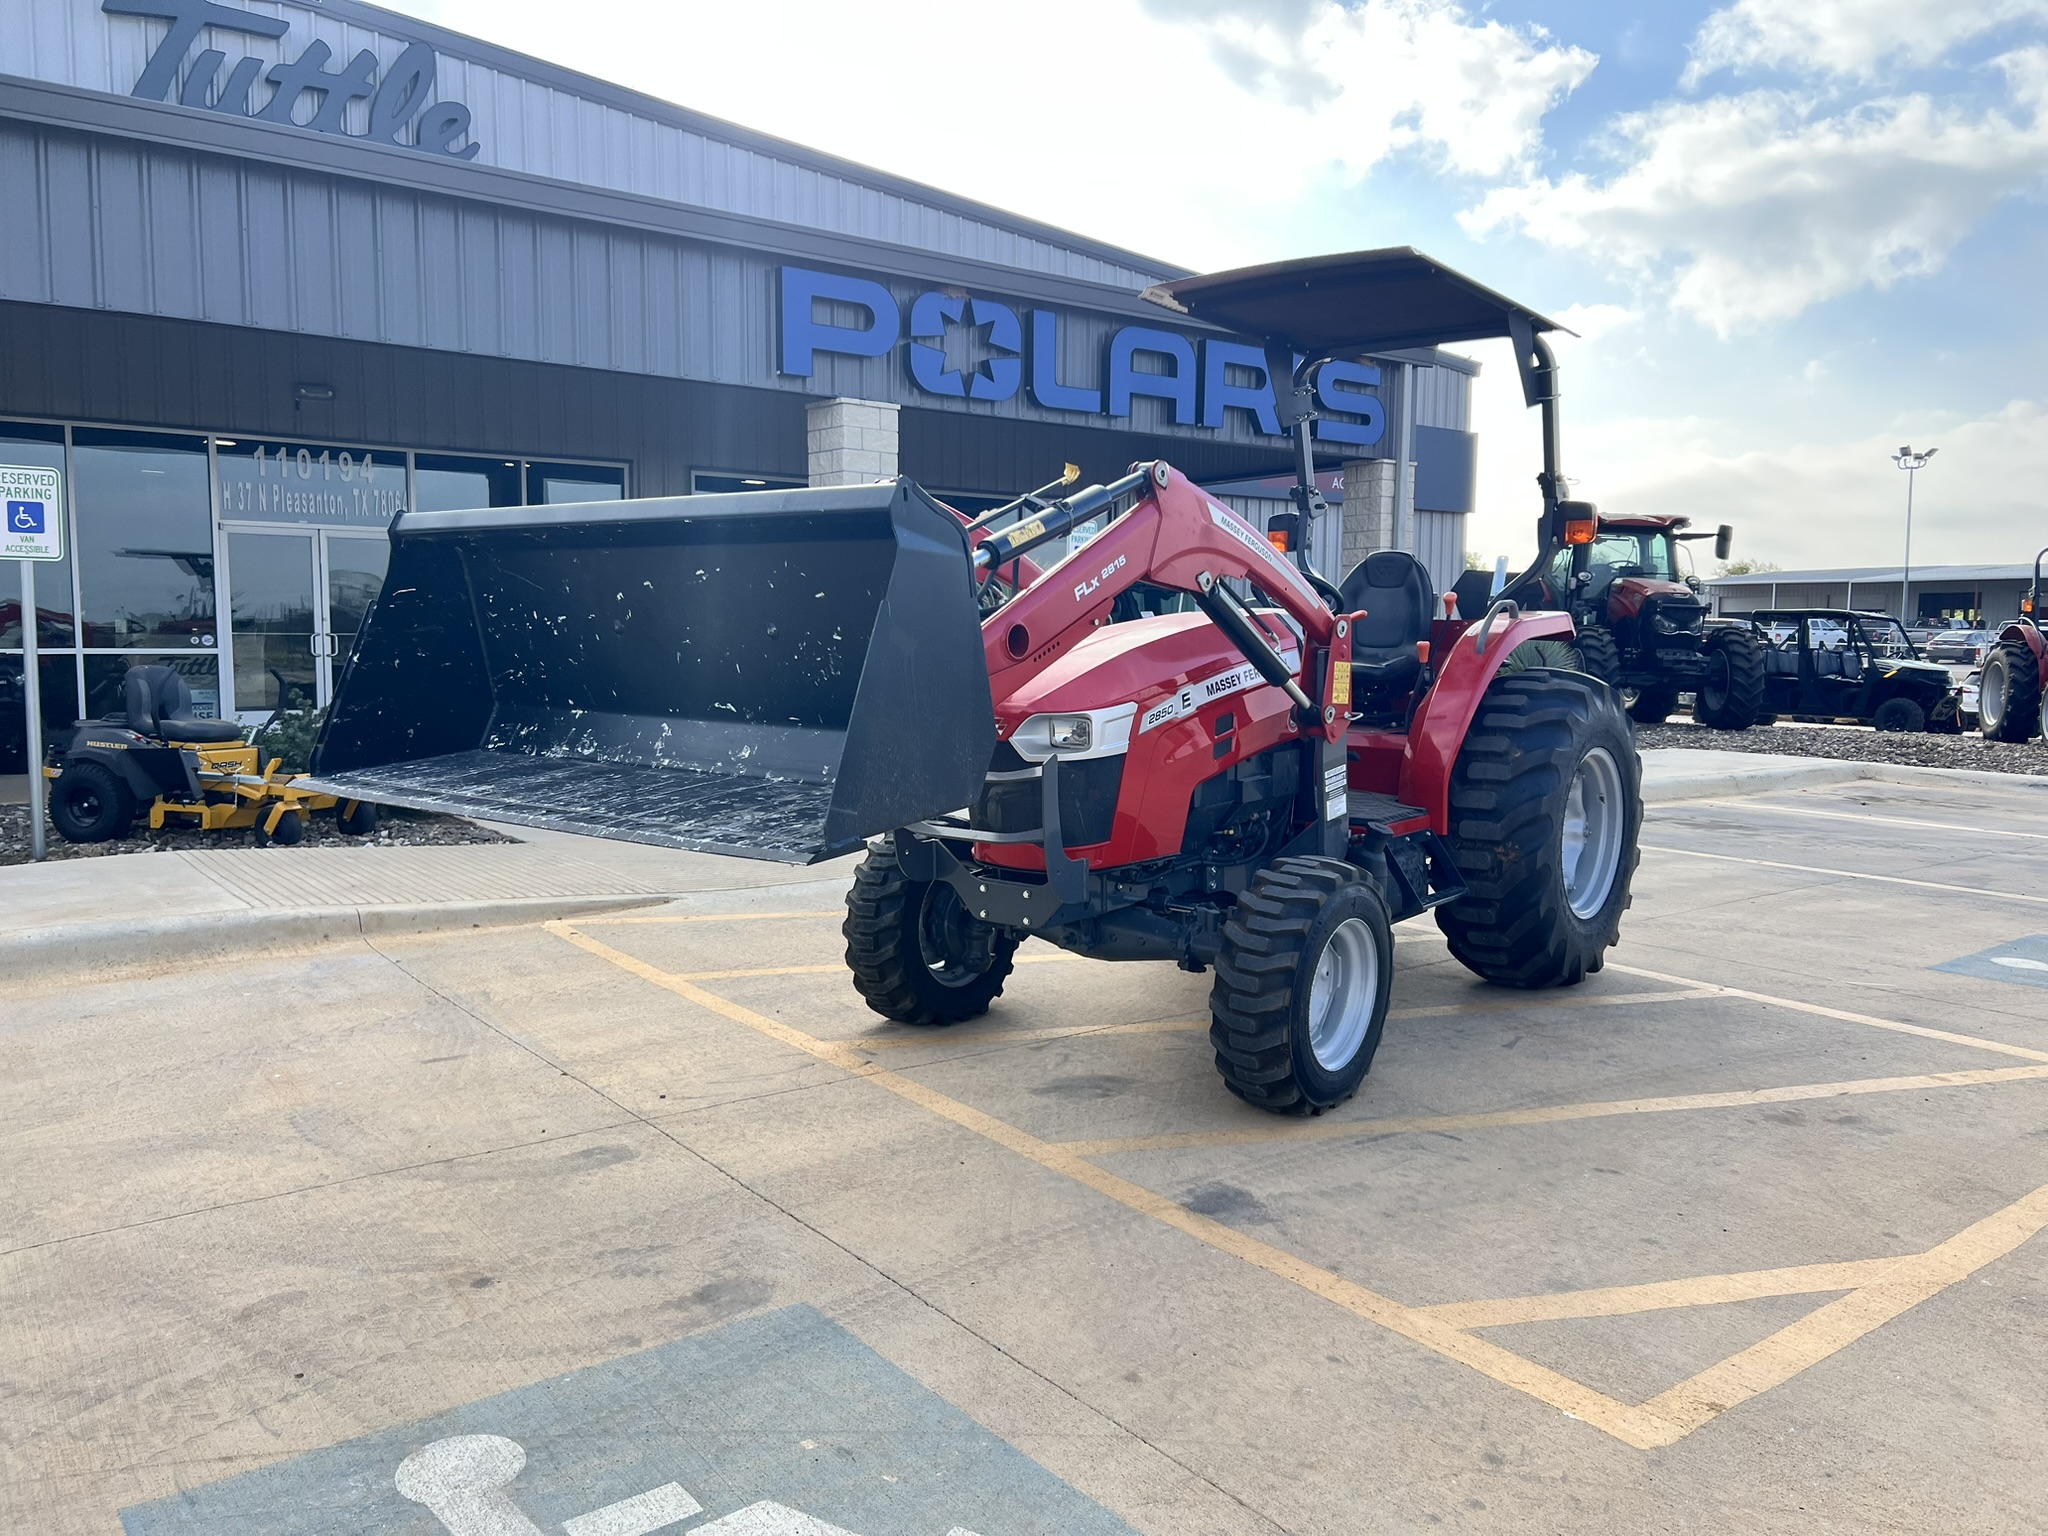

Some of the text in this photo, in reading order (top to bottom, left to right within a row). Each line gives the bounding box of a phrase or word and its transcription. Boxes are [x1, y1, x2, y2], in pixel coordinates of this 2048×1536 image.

[101, 0, 481, 161] Tuttle
[776, 265, 1386, 446] POLARS
[0, 472, 55, 487] ESERVED
[254, 445, 374, 484] 110194
[0, 486, 52, 500] PARKING
[238, 482, 251, 511] 37
[259, 484, 267, 512] N
[273, 485, 349, 521] Pleasanton,
[353, 488, 368, 516] TX
[5, 545, 50, 554] ACCESSIBLE
[20, 535, 35, 543] VAN
[1220, 516, 1273, 562] MASSEY FERGUSON
[1100, 554, 1127, 580] 2815
[1148, 673, 1242, 726] 2850 E MASSEY
[86, 739, 129, 750] HUSTLER
